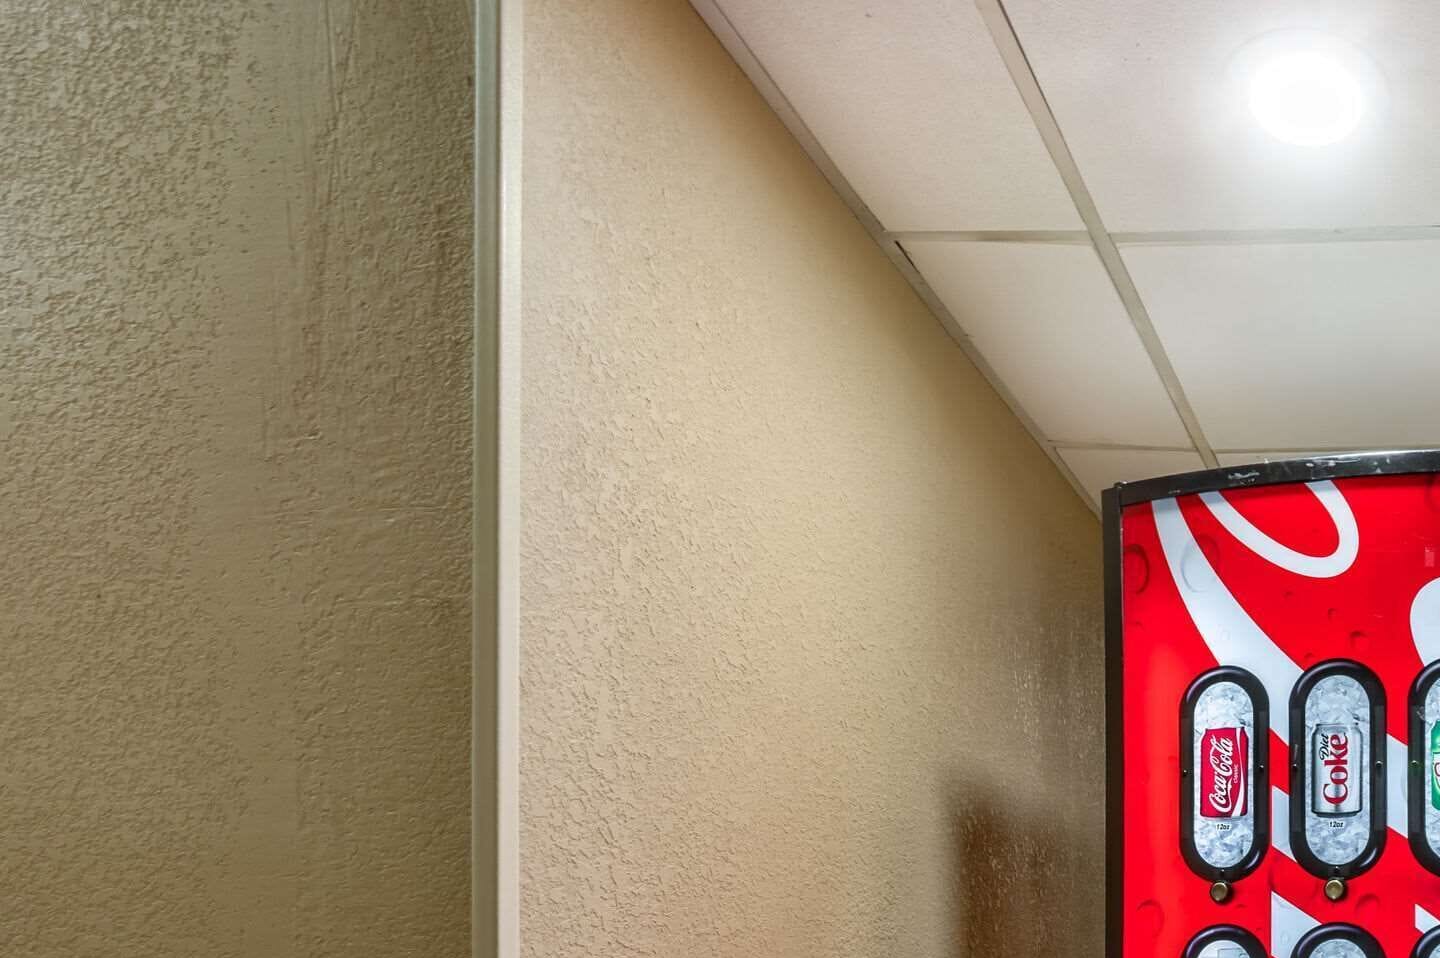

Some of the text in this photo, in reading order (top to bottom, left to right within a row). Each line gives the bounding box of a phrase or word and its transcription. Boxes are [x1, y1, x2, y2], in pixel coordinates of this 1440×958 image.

[1209, 734, 1233, 813] Coca-Cola
[1319, 732, 1330, 761] Diet
[1322, 732, 1349, 806] Coke
